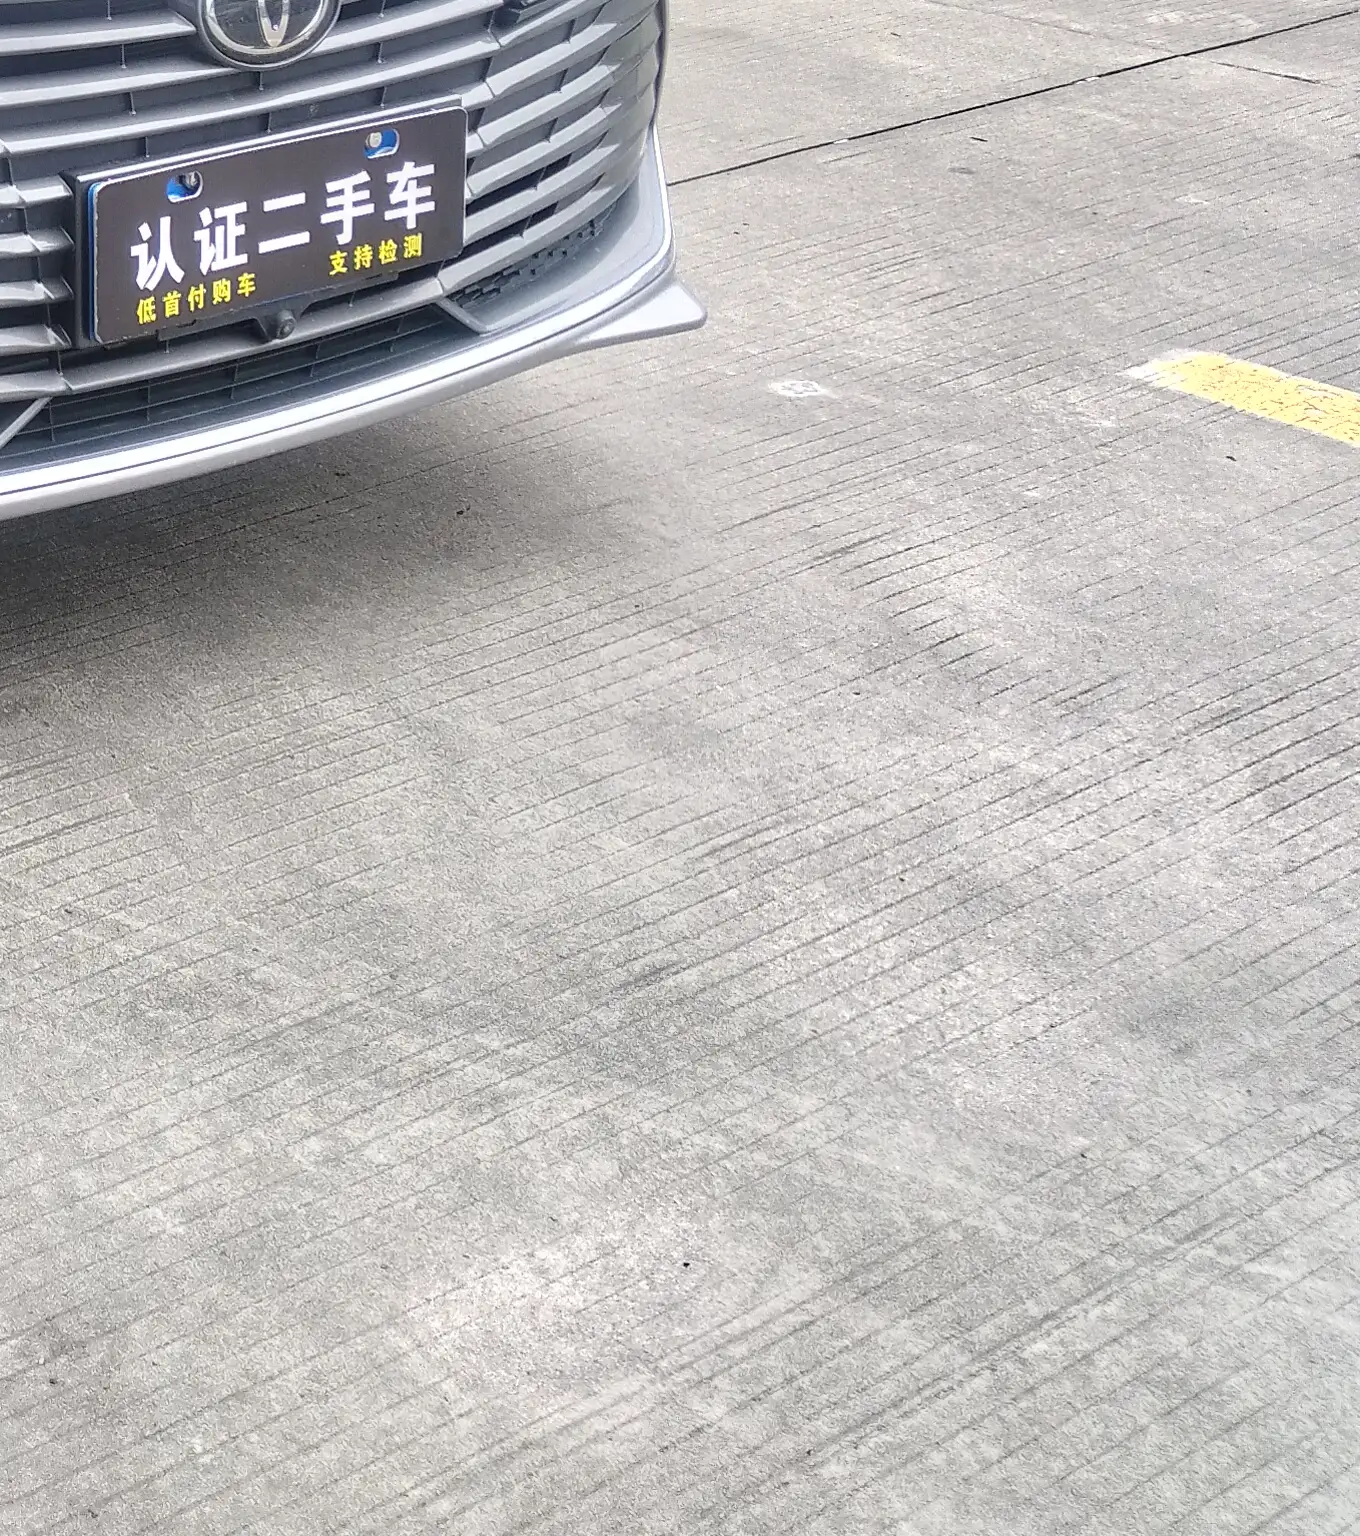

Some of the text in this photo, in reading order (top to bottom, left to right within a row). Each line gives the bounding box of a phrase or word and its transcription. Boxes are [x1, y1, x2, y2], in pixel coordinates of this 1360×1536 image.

[130, 160, 436, 291] 认证二手车
[135, 232, 423, 324] 低首付购车 支持检测
